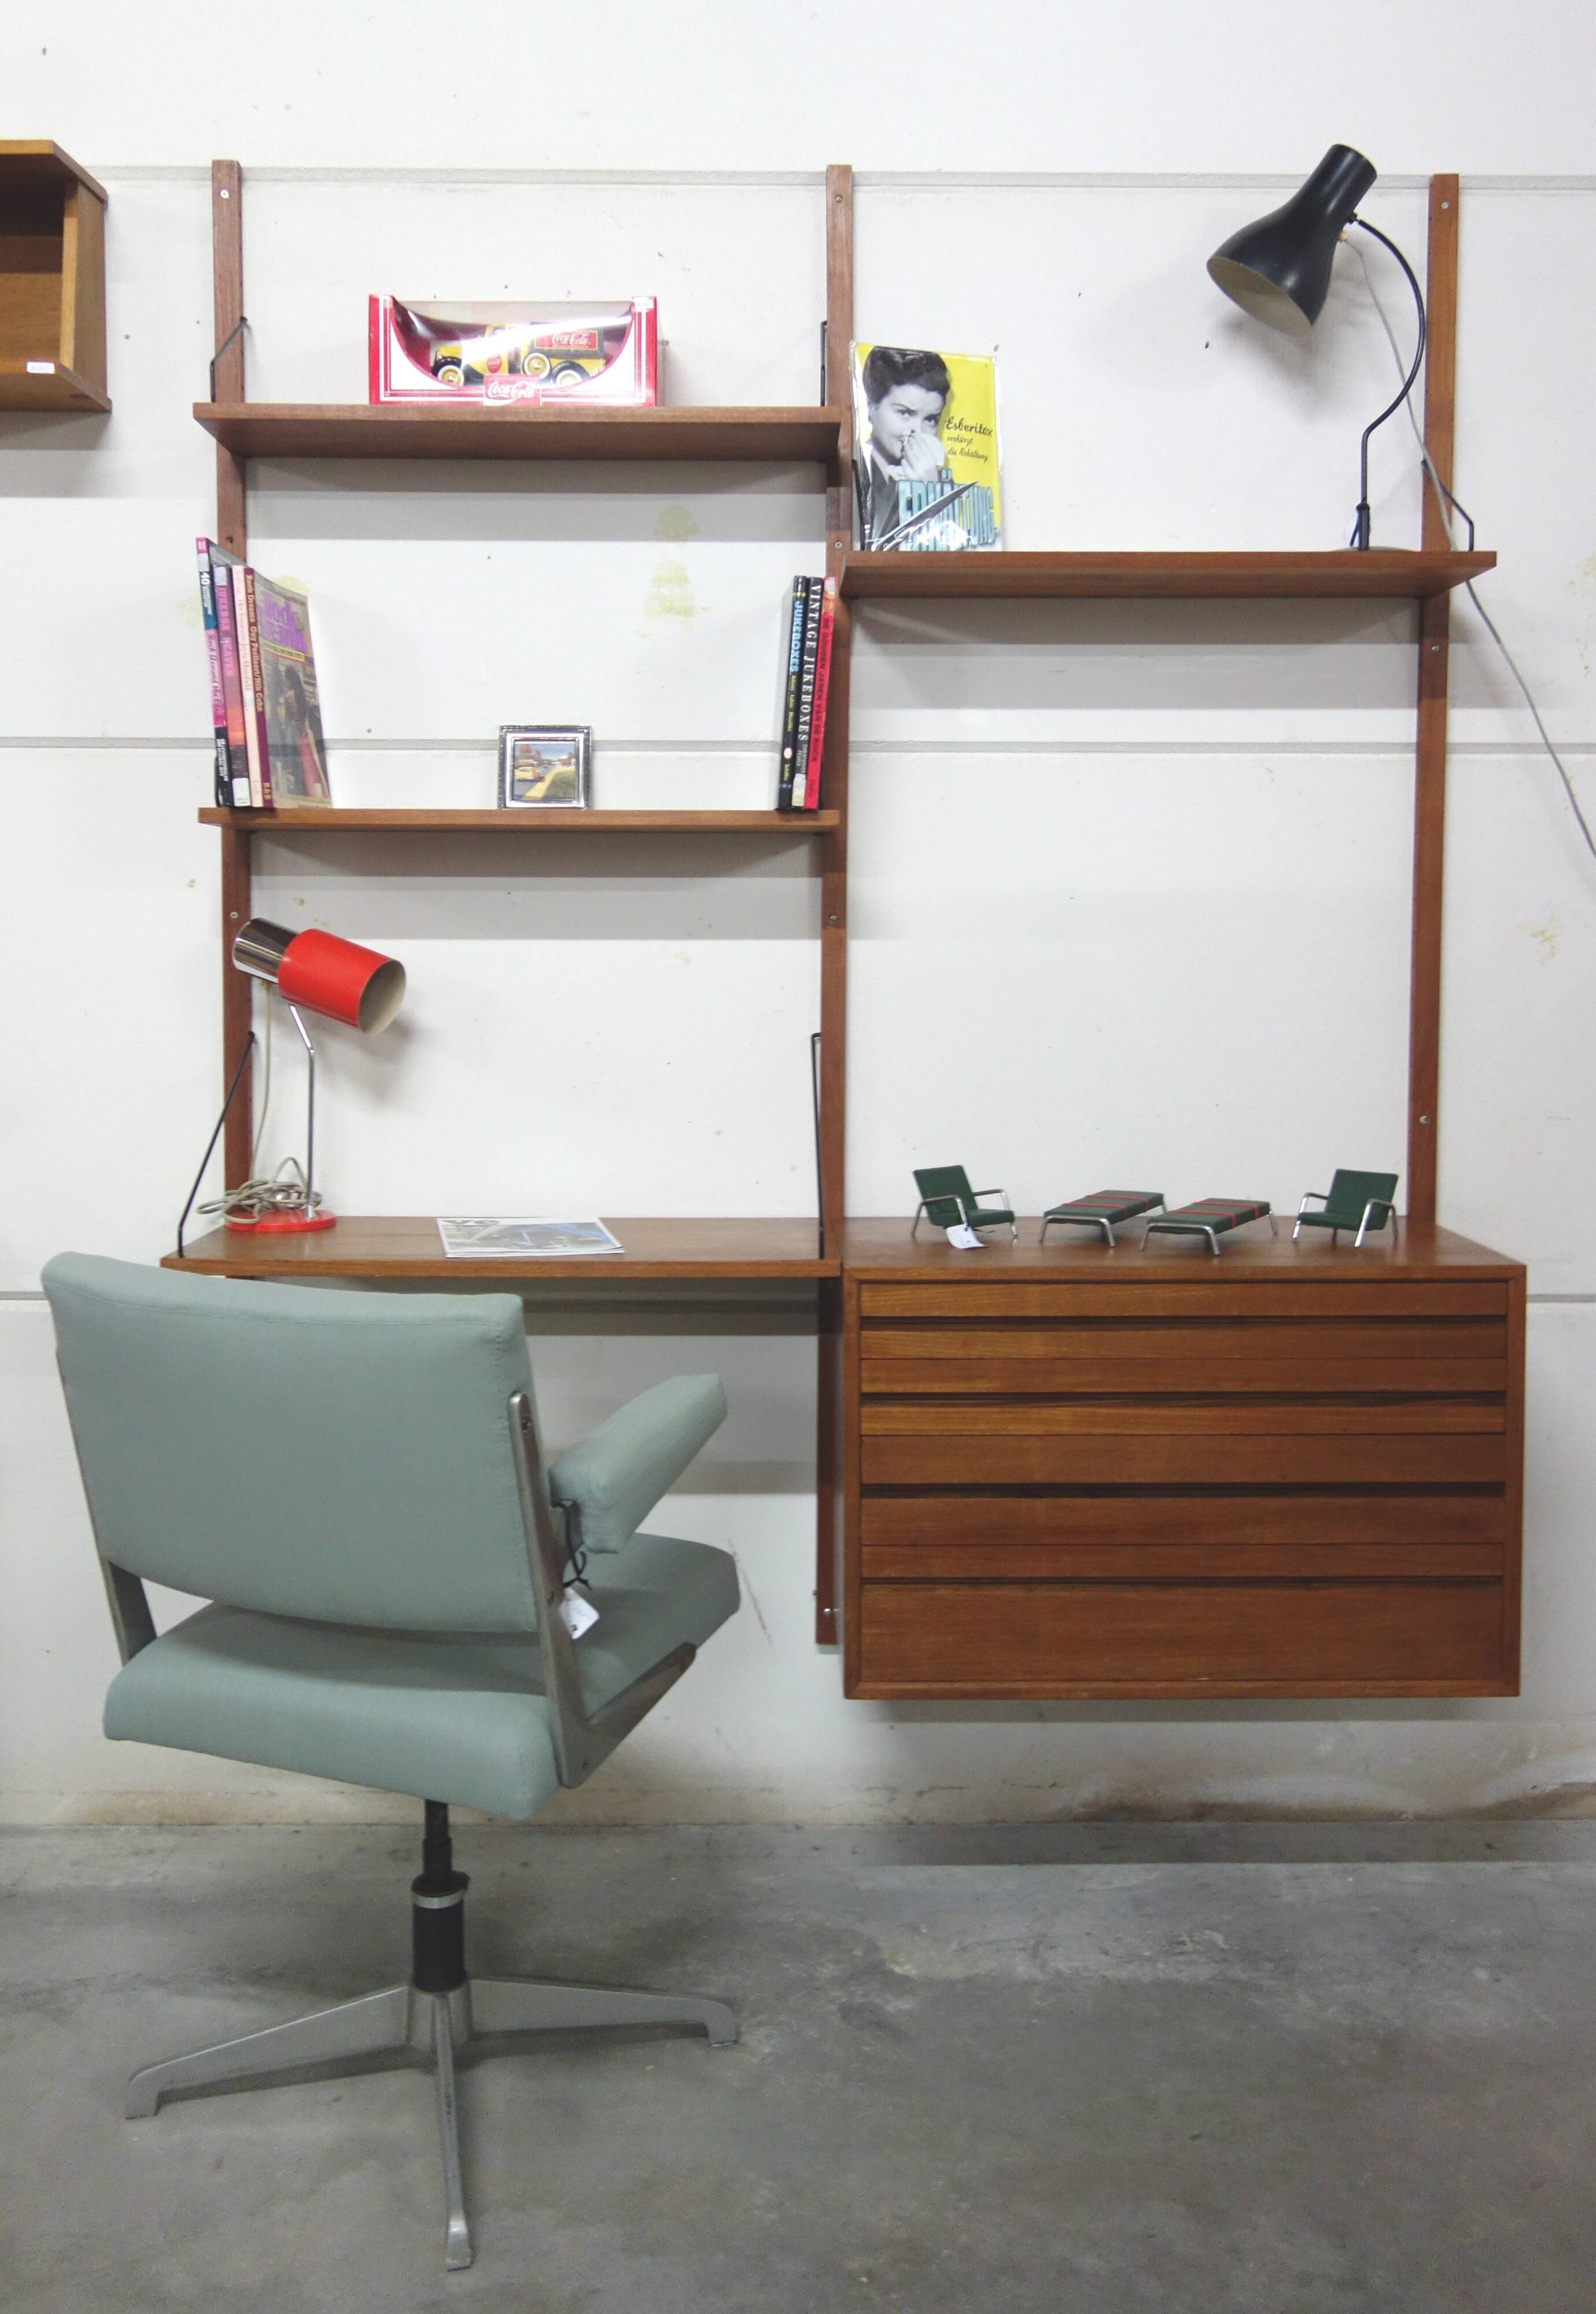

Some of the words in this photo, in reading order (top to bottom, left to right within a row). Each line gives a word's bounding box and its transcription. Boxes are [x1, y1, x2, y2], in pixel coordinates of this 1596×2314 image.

[945, 416, 994, 437] Esberitox
[946, 448, 957, 456] die
[200, 572, 211, 585] 40
[245, 574, 254, 594] Rock
[217, 586, 231, 631] JUKEBOX
[247, 595, 256, 622] Dreams
[806, 585, 821, 648] VINTAGE
[250, 626, 258, 642] Guy
[790, 600, 803, 672] JUKEBOXES
[823, 618, 830, 630] DE
[820, 632, 828, 669] GOUDEN
[798, 655, 816, 740] JUKEBOXES
[817, 672, 825, 701] JAREN
[814, 724, 820, 735] DE
